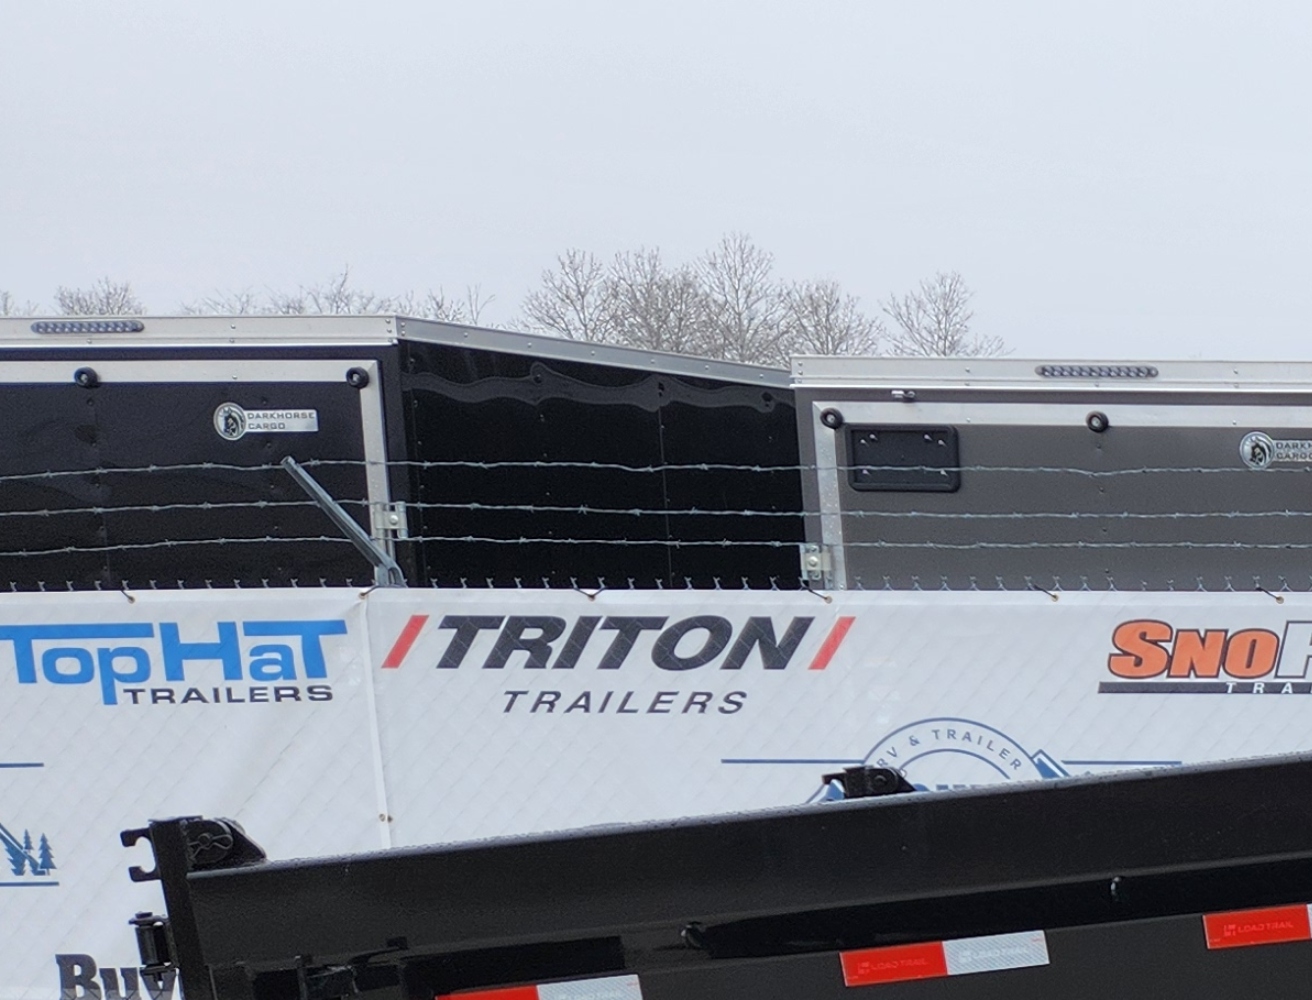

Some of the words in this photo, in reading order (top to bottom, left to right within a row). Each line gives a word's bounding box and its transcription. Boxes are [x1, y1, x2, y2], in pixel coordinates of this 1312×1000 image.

[247, 411, 316, 420] DARKHORSE
[247, 422, 286, 430] CARGO
[435, 614, 816, 672] TRITON
[123, 685, 334, 705] TRAILERS
[502, 690, 749, 715] TRAILERS
[908, 734, 921, 747] &
[931, 728, 1023, 770] TRAILER
